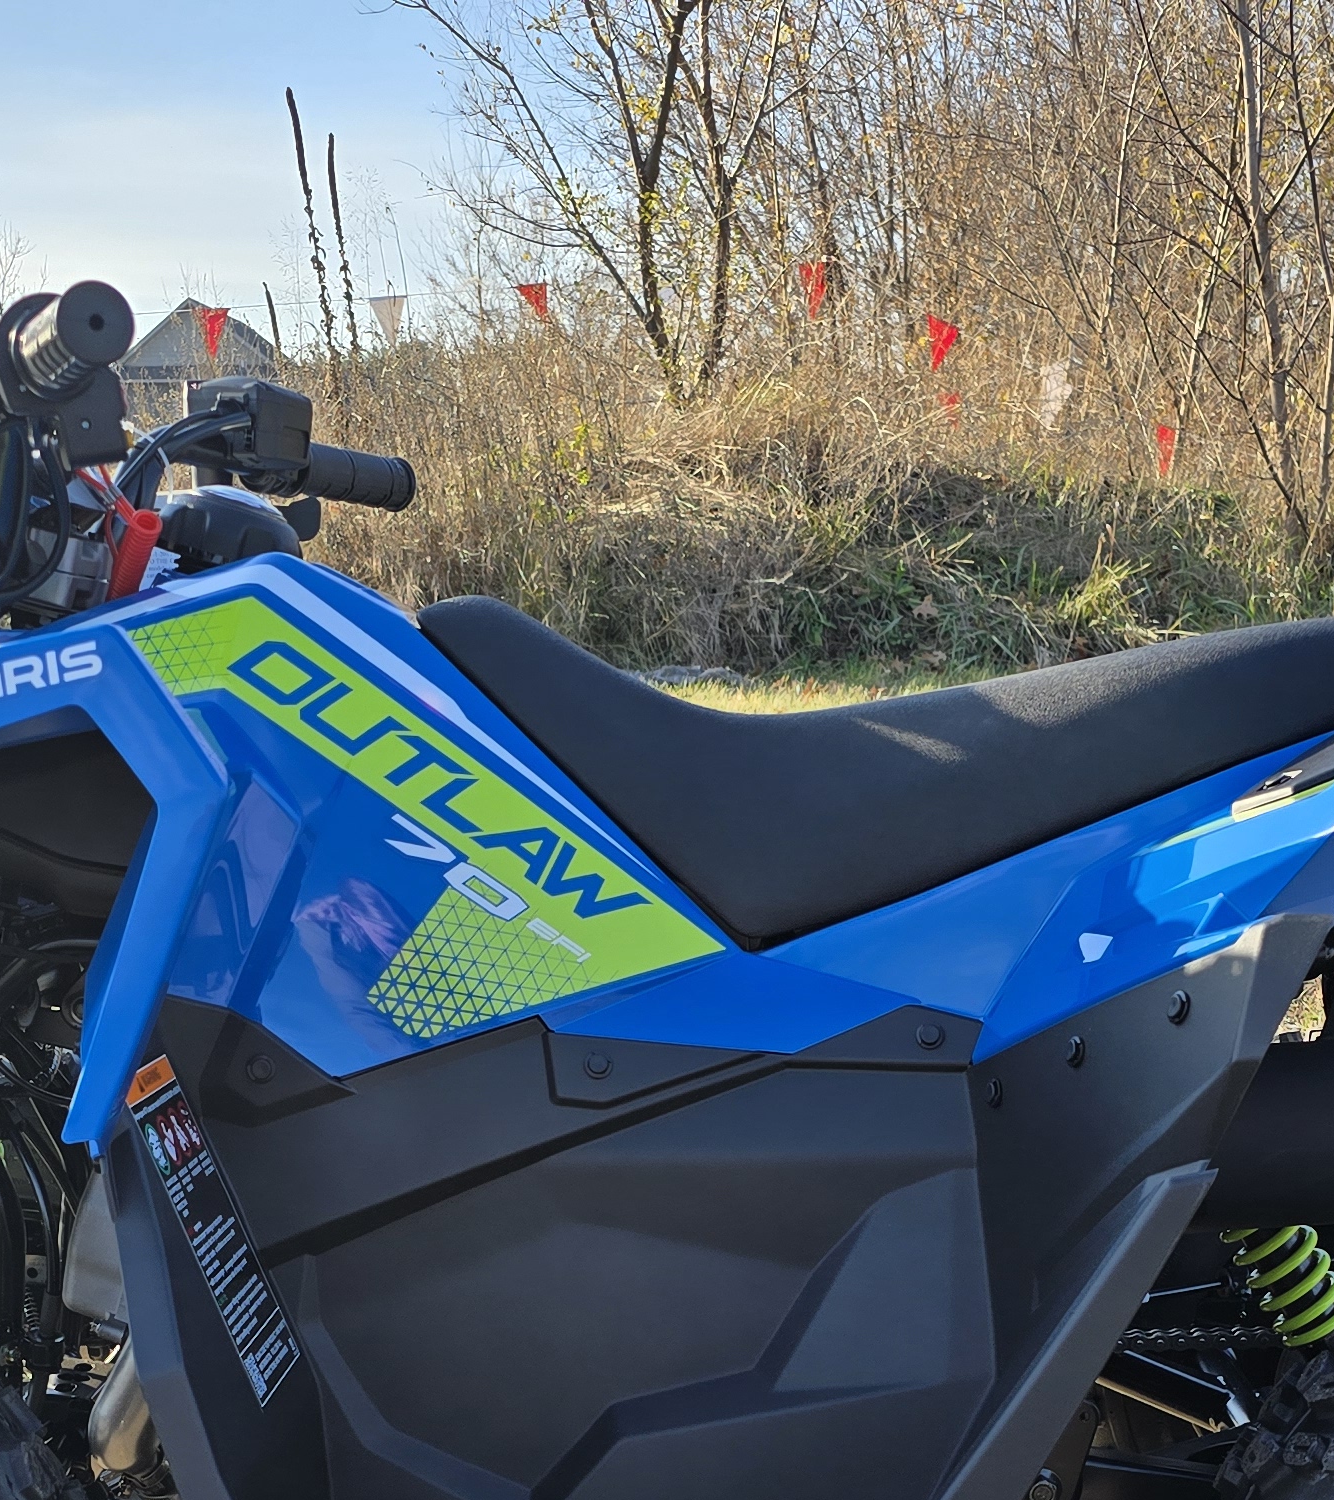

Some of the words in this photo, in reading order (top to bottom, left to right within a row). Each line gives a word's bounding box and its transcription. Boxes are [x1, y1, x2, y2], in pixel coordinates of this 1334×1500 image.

[228, 640, 652, 919] OUTLAW
[381, 811, 530, 923] 70
[525, 917, 592, 963] EFI
